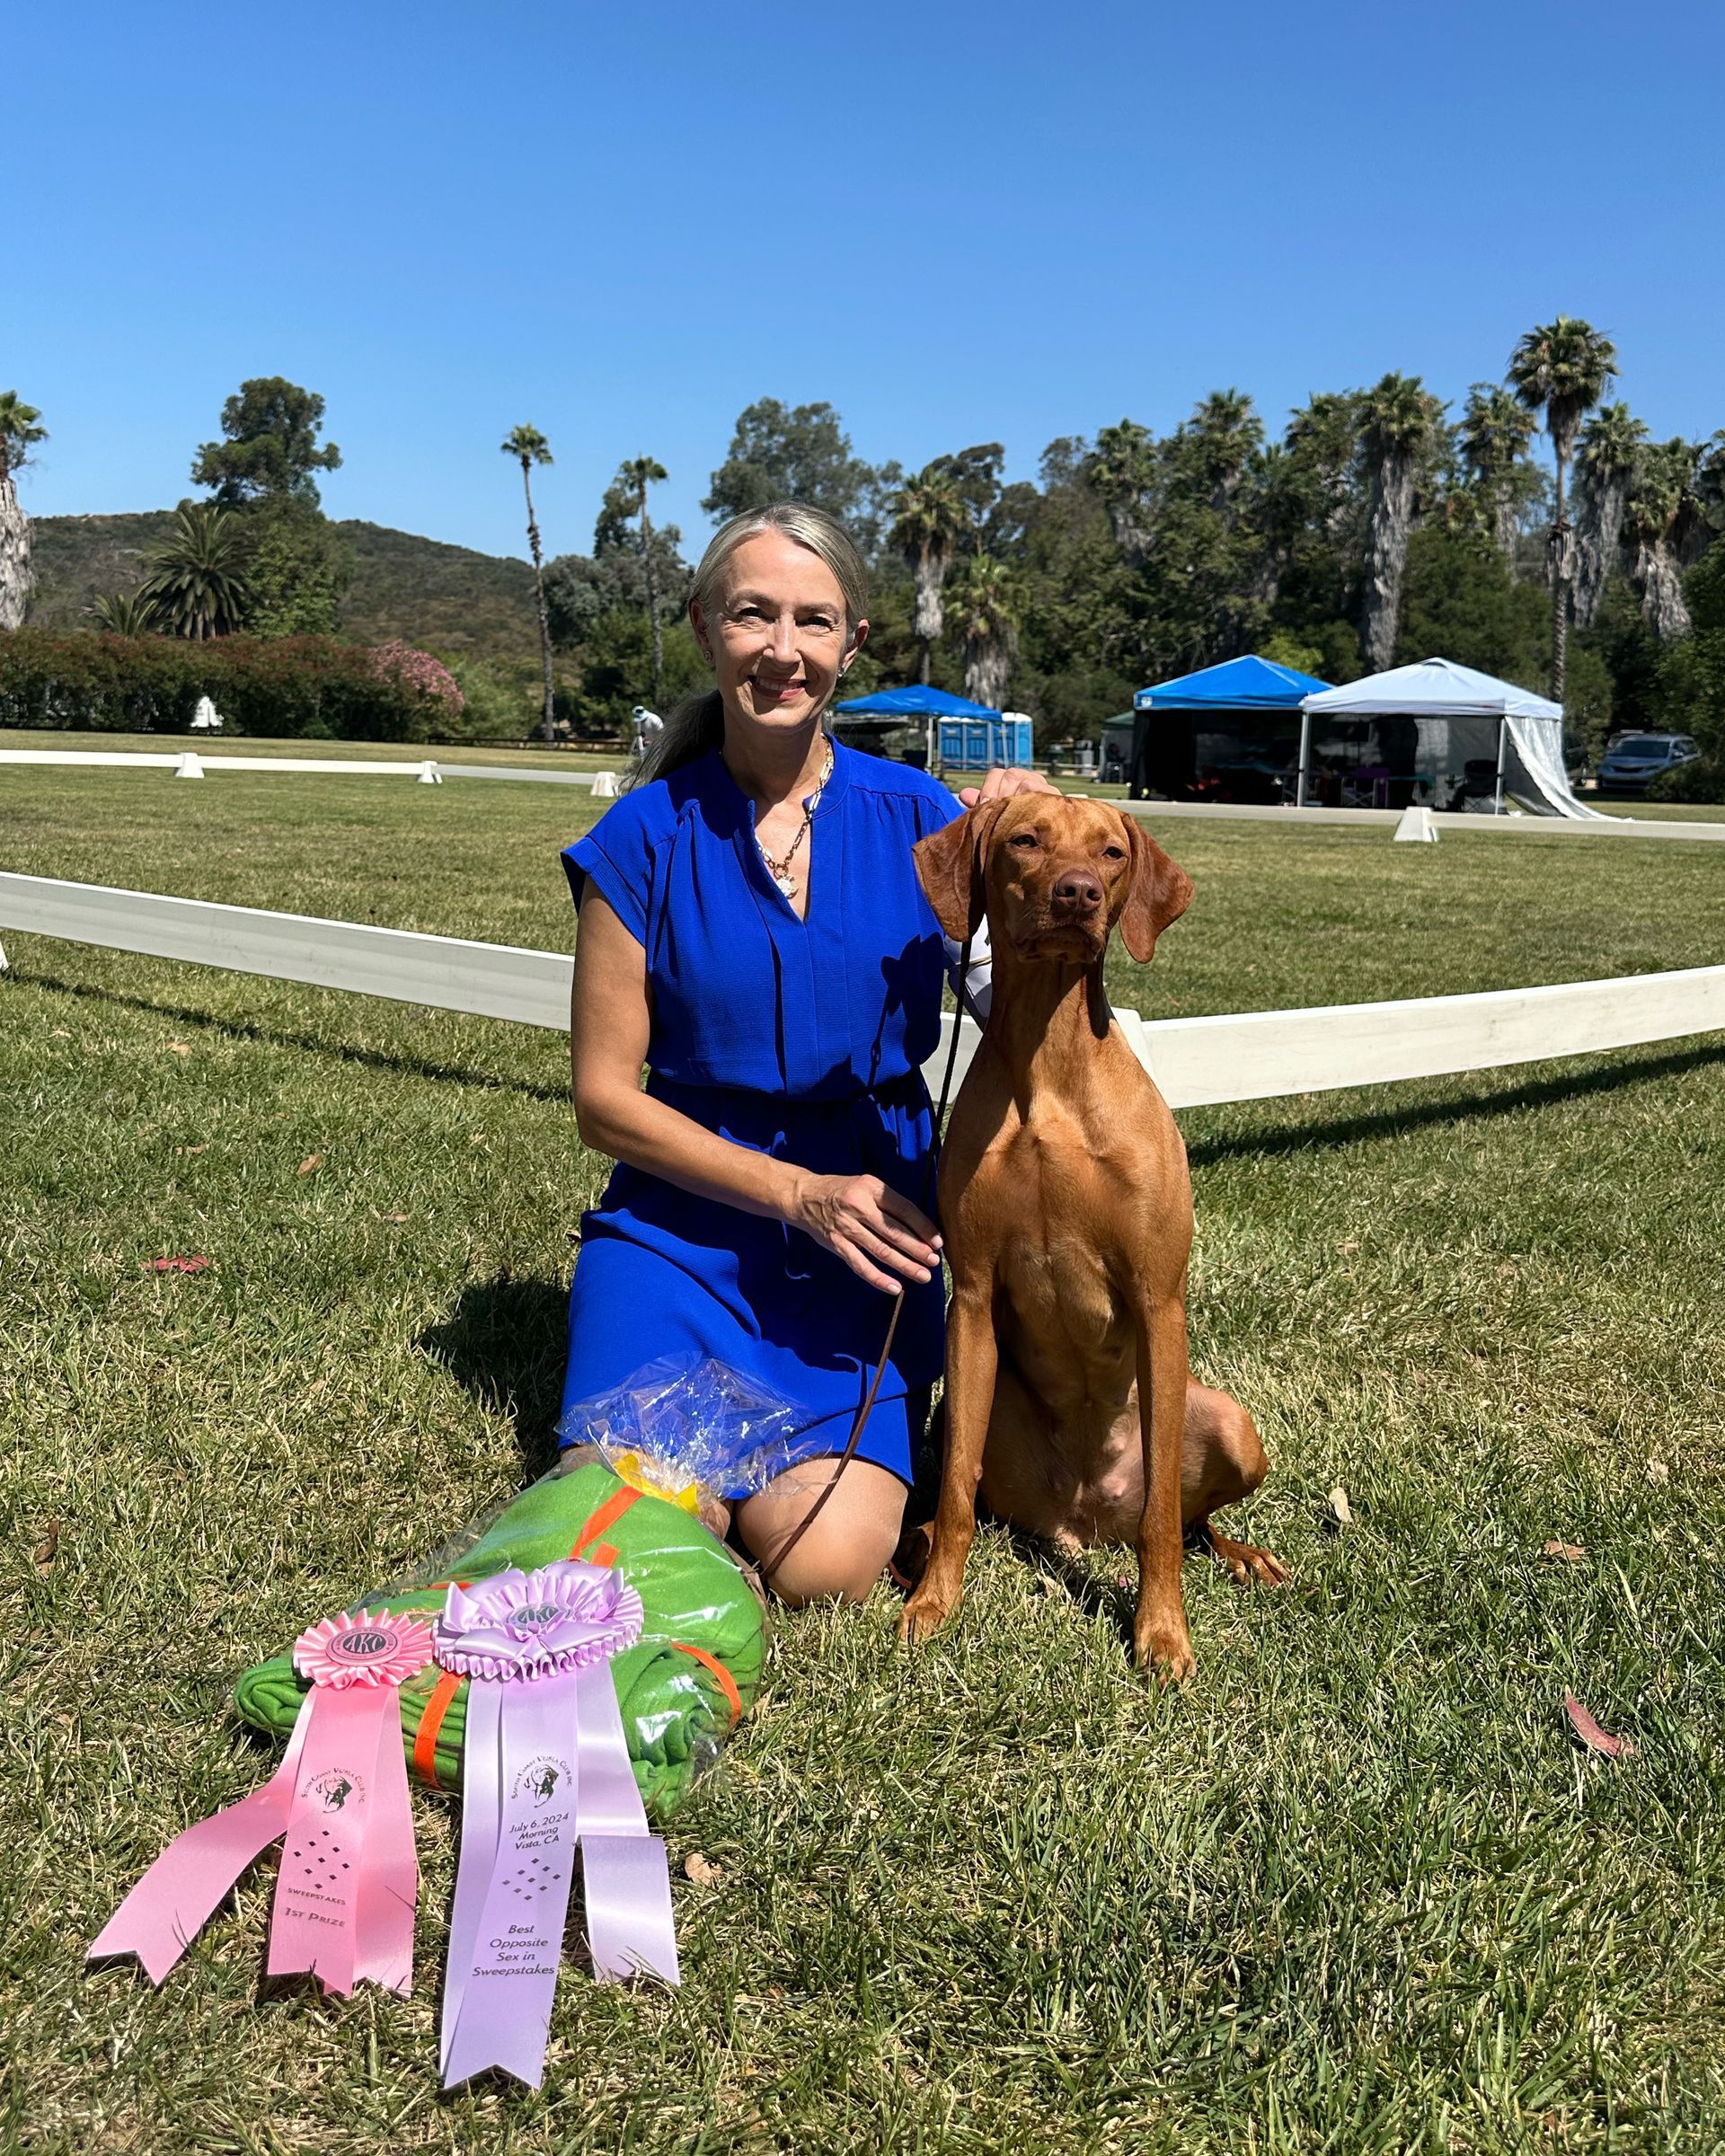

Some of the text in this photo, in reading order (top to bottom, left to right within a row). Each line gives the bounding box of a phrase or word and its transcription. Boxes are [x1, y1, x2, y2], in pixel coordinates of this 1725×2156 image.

[520, 1606, 558, 1623] AKC
[344, 1633, 384, 1654] AKC
[509, 1812, 569, 1833] July 6, 2024
[518, 1826, 559, 1841] Morning
[515, 1834, 560, 1851] Vista, CA
[288, 1887, 346, 1905] SWEEPSTAKES
[285, 1907, 346, 1927] 1ST PRIZE
[508, 1924, 535, 1934] Best
[490, 1938, 549, 1949] Opposite
[496, 1951, 535, 1962] Sex in
[472, 1963, 555, 1977] Sweepstakes
